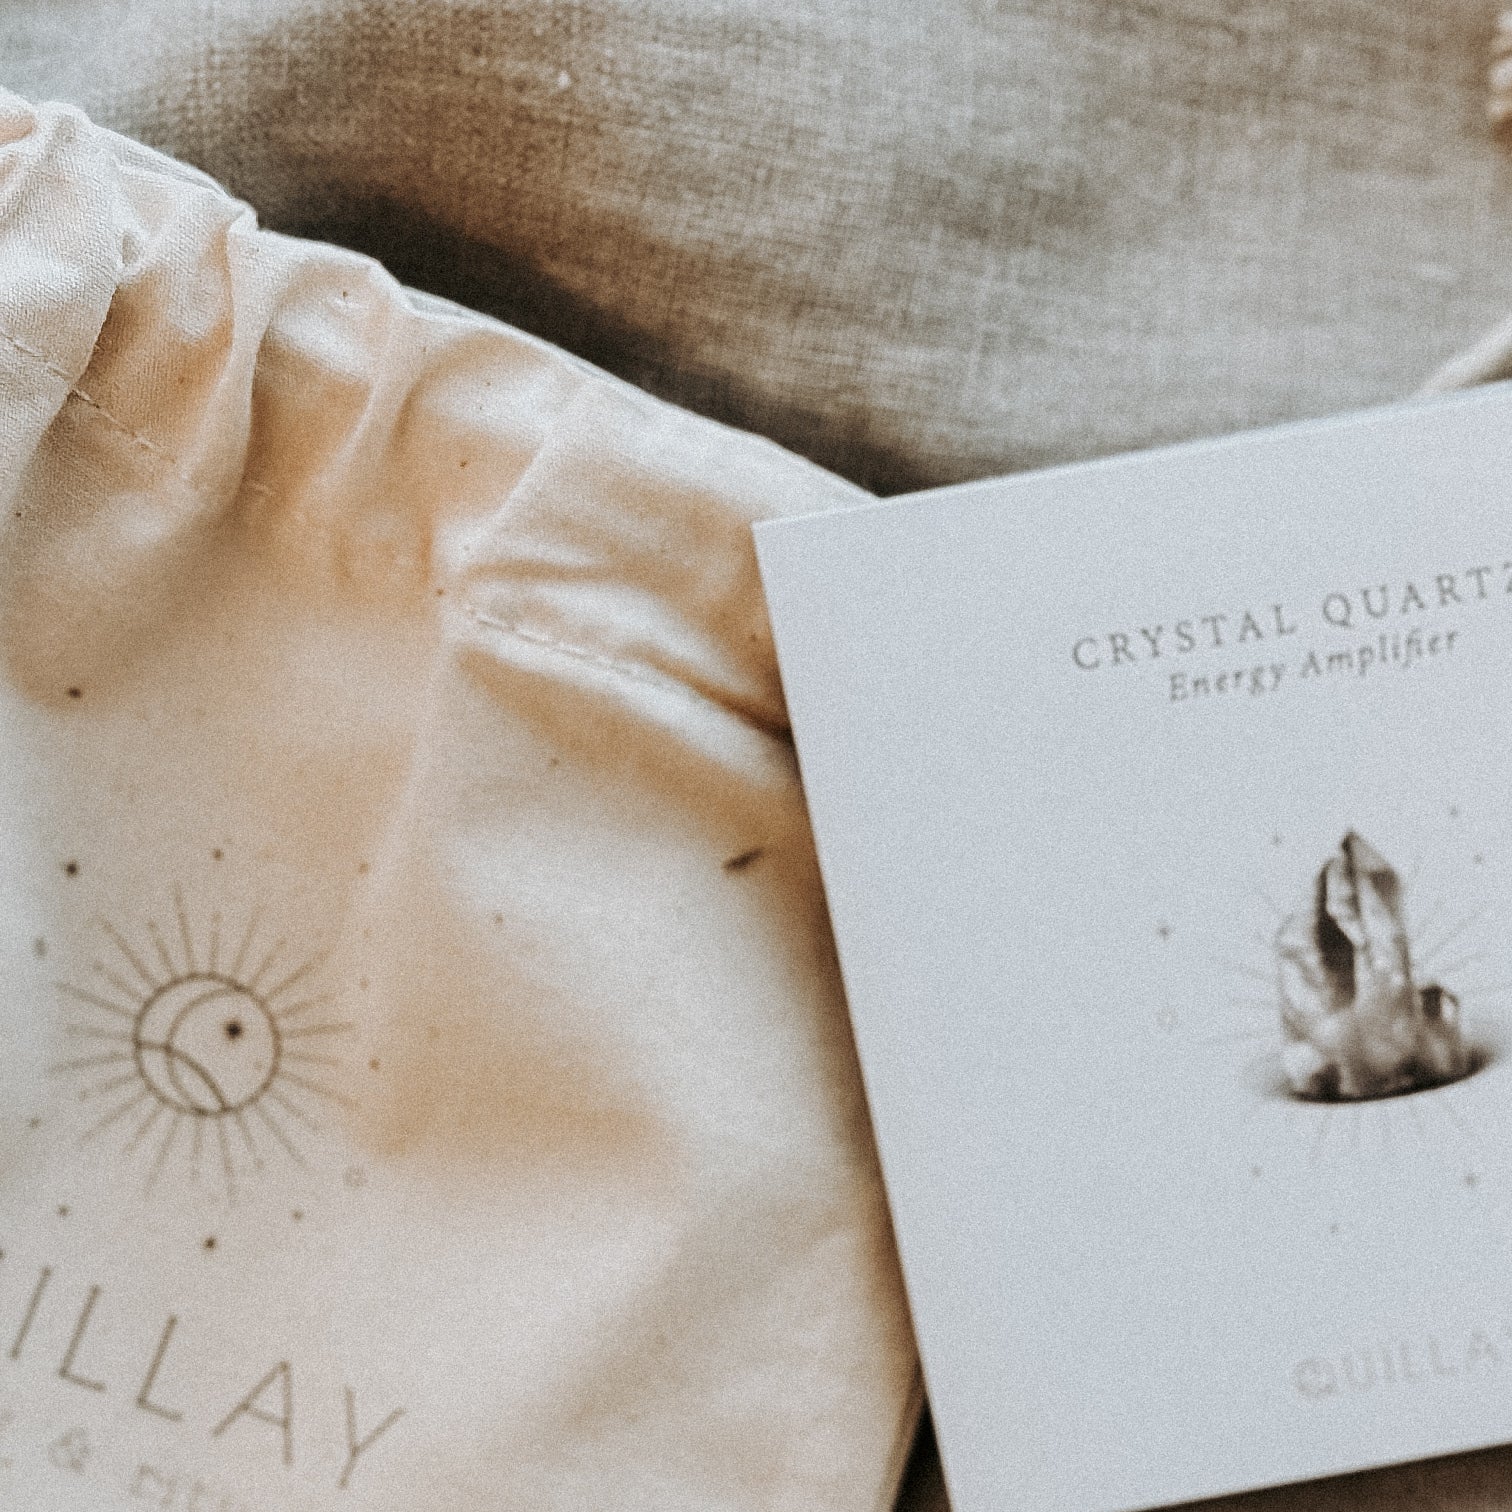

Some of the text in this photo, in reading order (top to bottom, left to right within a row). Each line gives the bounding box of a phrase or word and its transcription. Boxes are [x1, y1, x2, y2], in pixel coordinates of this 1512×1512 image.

[1071, 604, 1297, 671] CRYSTAL
[1167, 627, 1461, 703] Energy Amplifier
[0, 1248, 406, 1490] ILLAY
